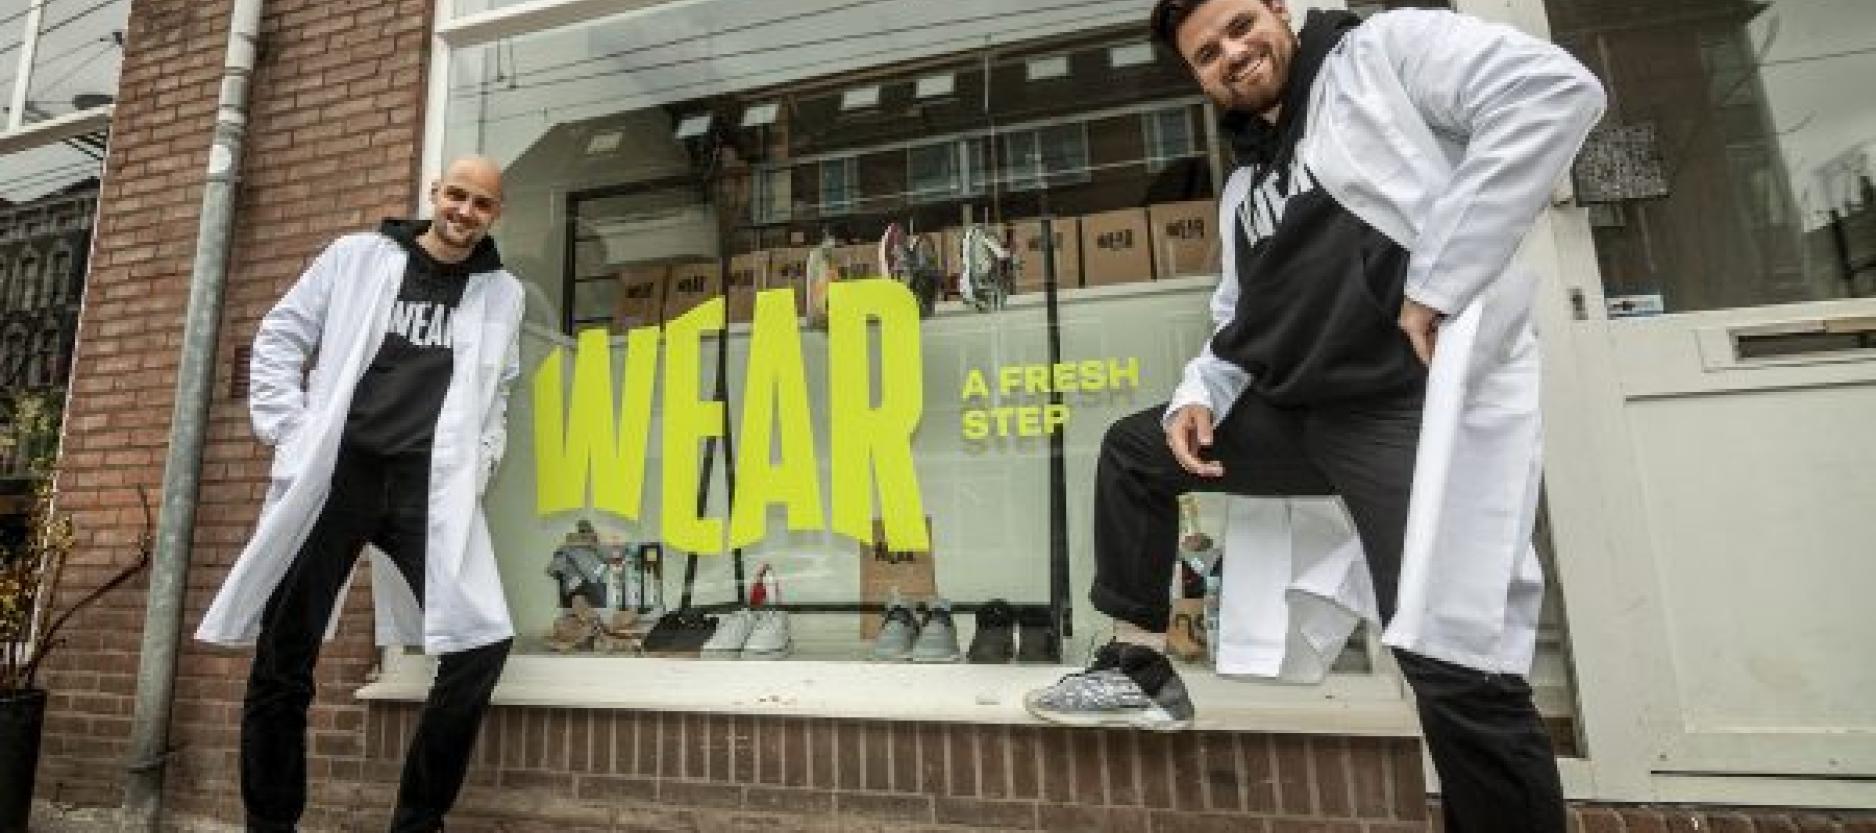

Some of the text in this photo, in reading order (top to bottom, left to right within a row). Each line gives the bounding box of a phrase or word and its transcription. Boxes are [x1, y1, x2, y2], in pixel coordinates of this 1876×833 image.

[962, 357, 1139, 399] A FRESH
[533, 279, 930, 554] WEAR
[963, 405, 1070, 439] STEP
